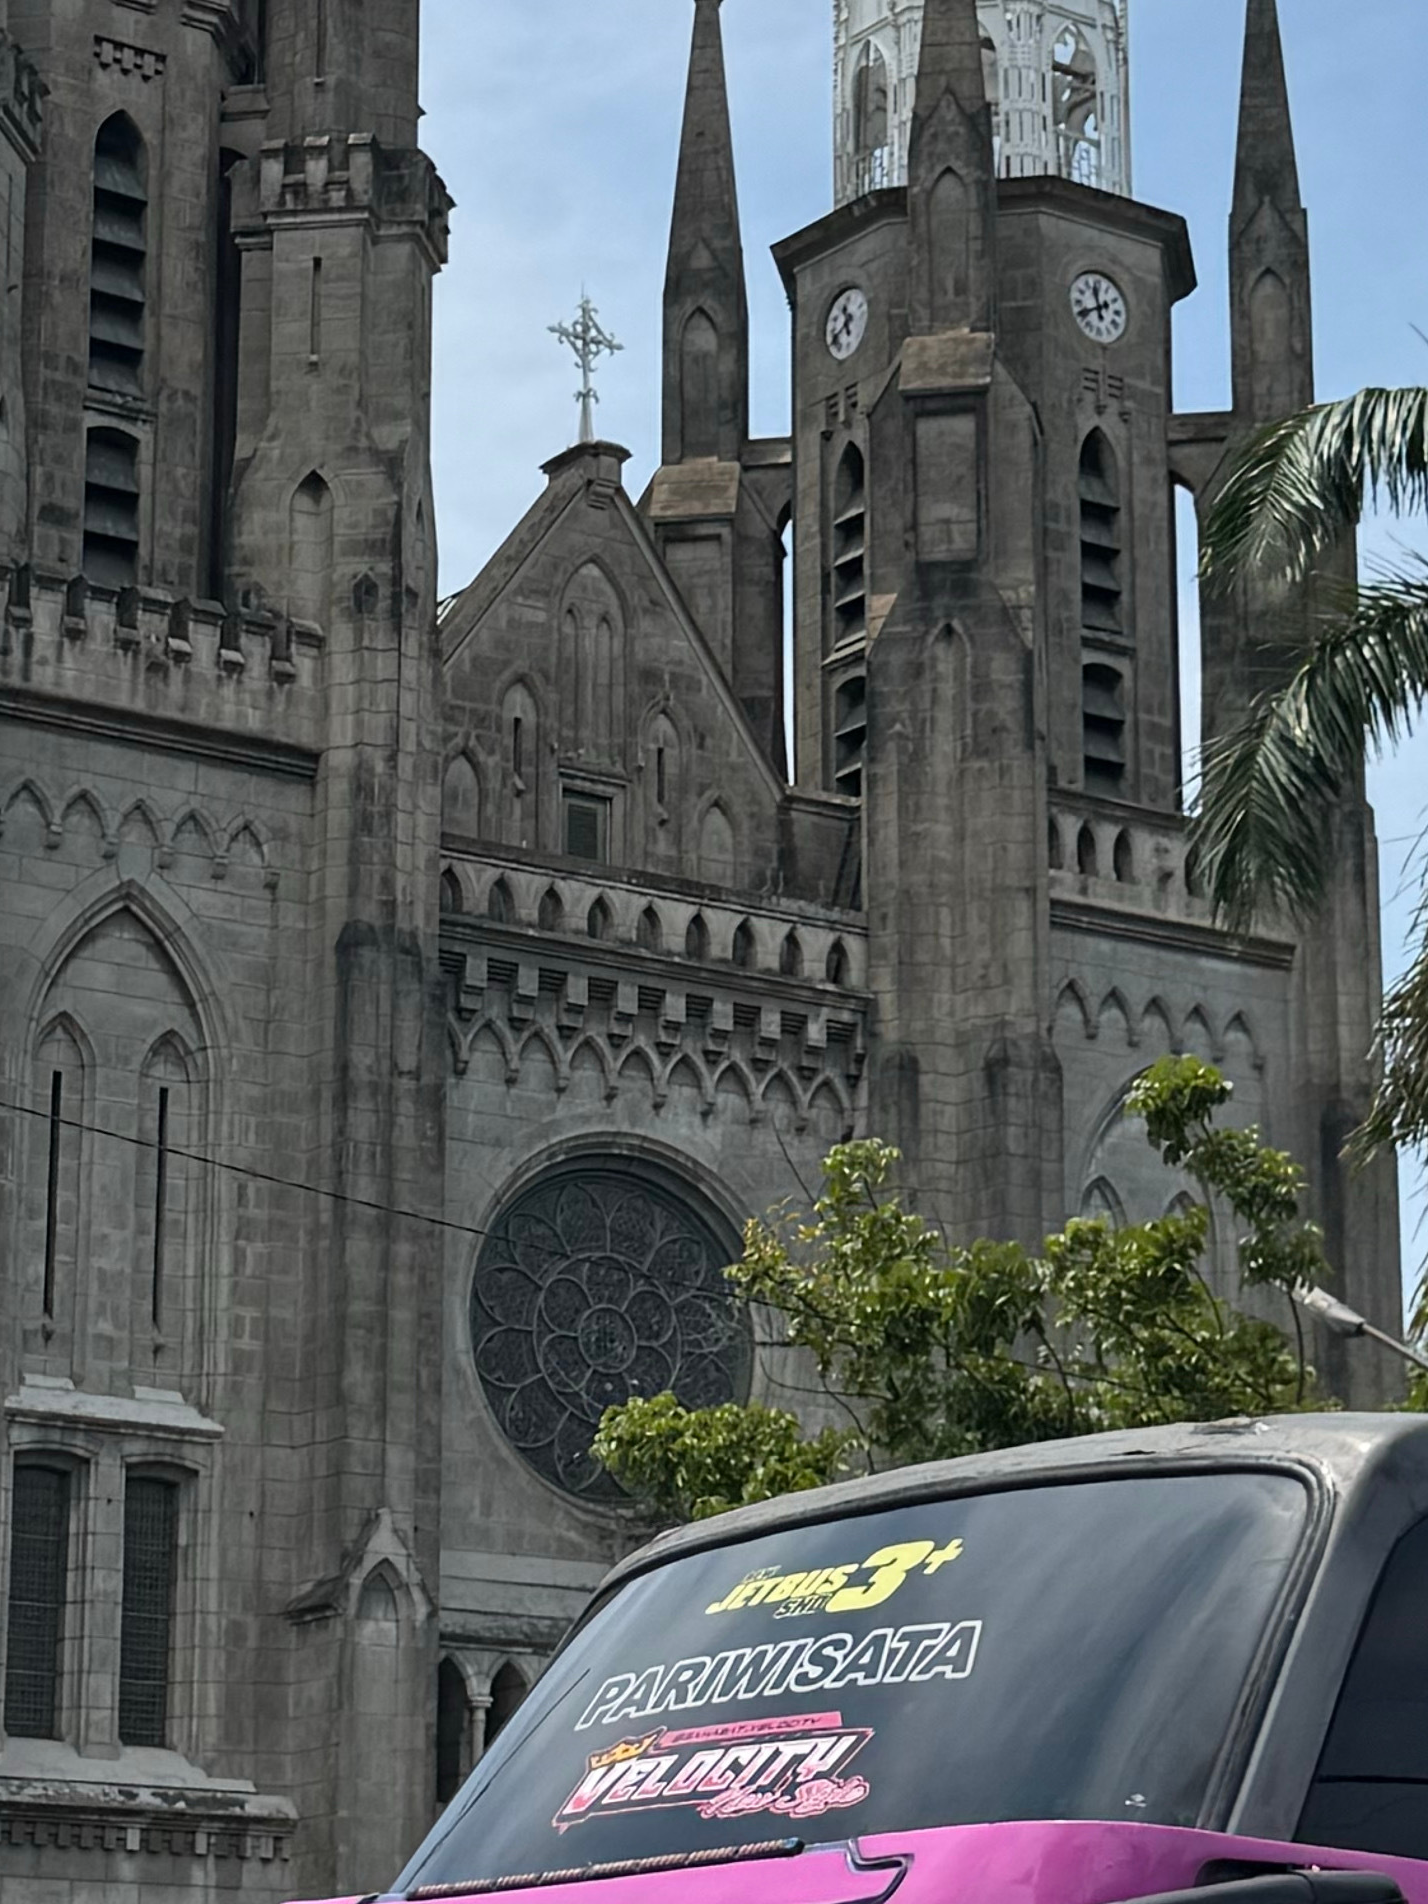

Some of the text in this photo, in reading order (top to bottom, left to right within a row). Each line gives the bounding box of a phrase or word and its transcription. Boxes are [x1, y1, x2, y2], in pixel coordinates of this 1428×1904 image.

[705, 1563, 860, 1614] JETBUS
[574, 1619, 982, 1731] PARIWISATA
[561, 1734, 858, 1816] VELOCITY
